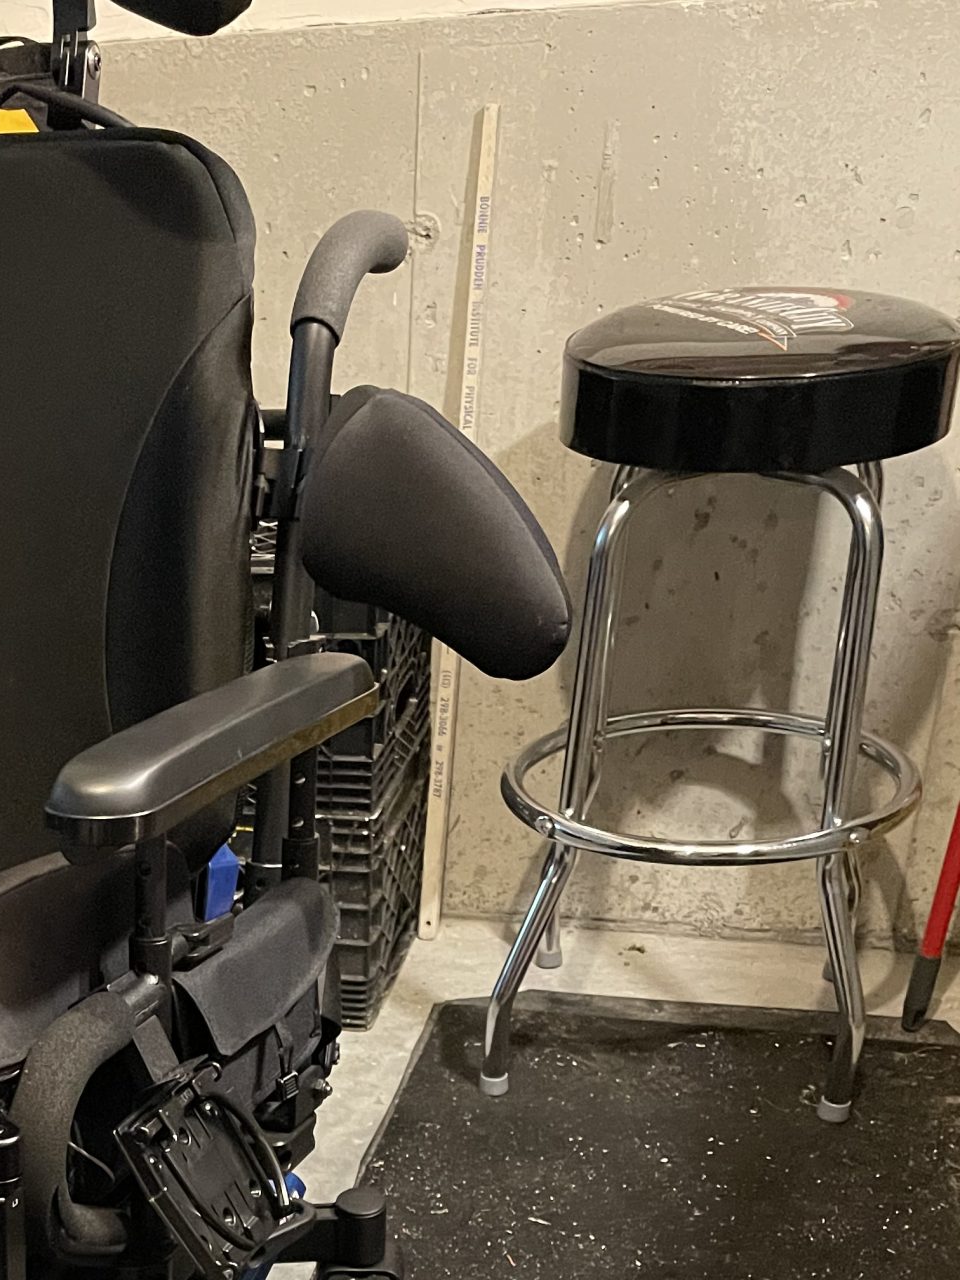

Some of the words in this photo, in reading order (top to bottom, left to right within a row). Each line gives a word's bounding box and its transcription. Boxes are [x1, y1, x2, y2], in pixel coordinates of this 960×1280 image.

[469, 301, 483, 347] INSTITUTE
[466, 357, 477, 376] FOR
[463, 385, 476, 430] PHYSICAL
